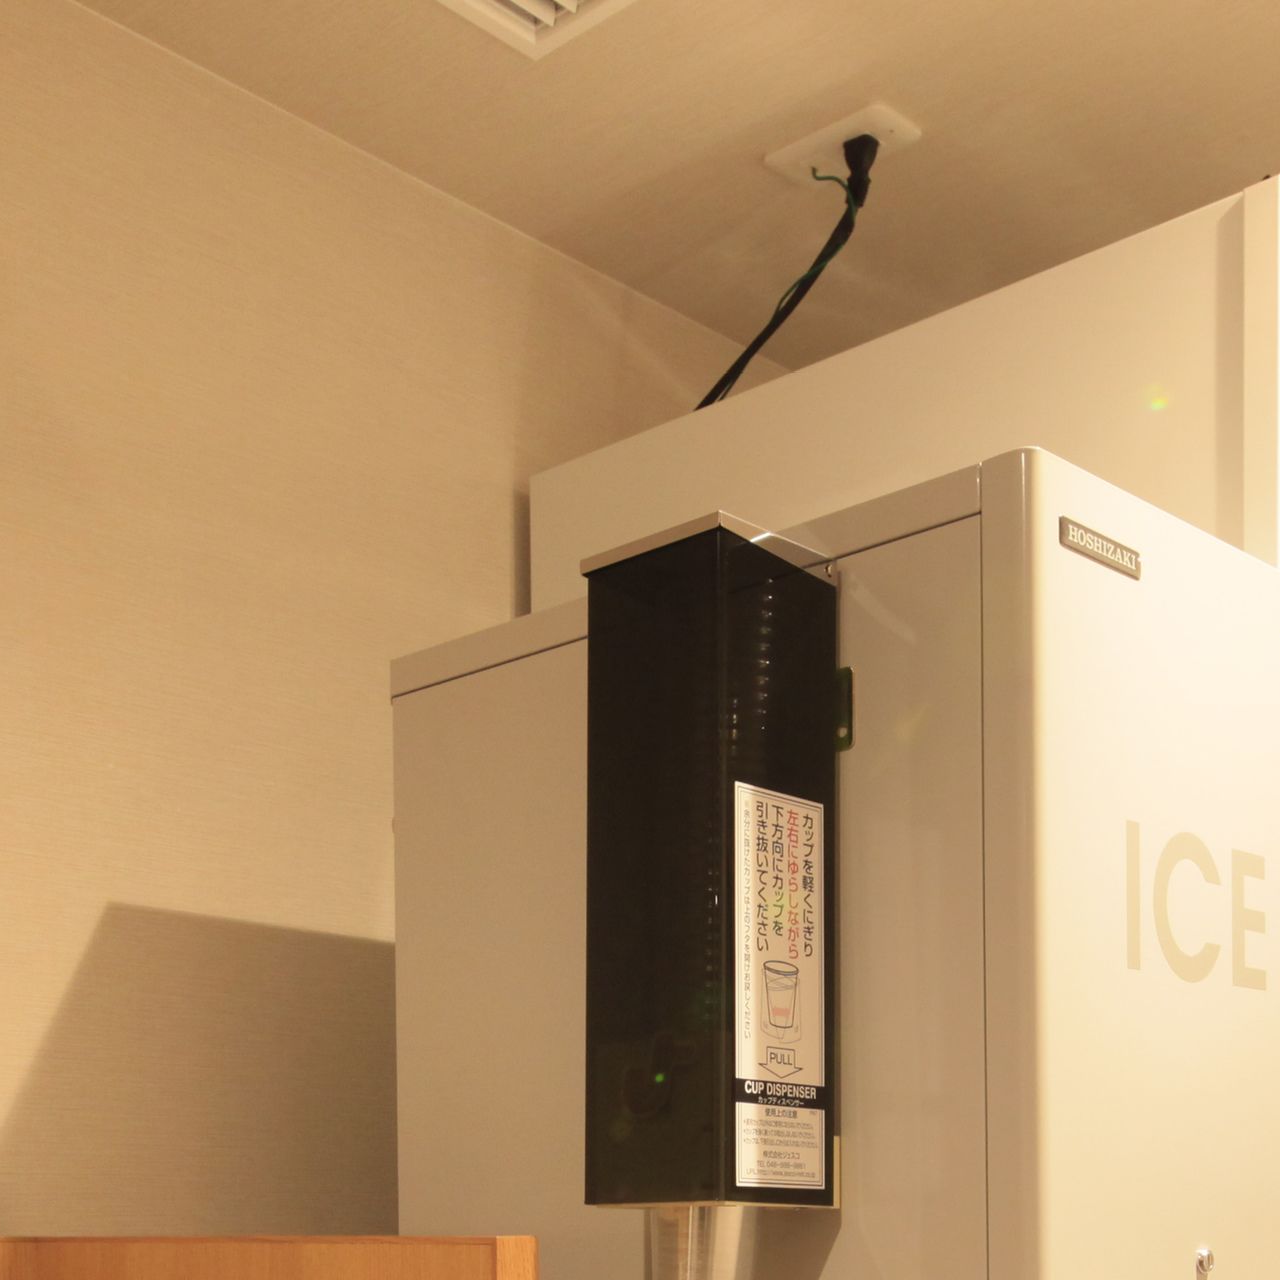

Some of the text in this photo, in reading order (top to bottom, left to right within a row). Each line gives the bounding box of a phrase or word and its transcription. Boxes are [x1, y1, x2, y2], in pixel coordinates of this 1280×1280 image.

[1068, 524, 1137, 570] HOSHIZAKI
[755, 801, 769, 952] 引き抜いてください
[771, 804, 784, 937] 下方向にカップを
[787, 809, 800, 960] 左右にゆらしながら
[802, 813, 814, 958] カップを軽くにぎり
[1125, 819, 1267, 992] ICE
[744, 1080, 817, 1100] CUP DISPENSER
[769, 1051, 793, 1066] PULL
